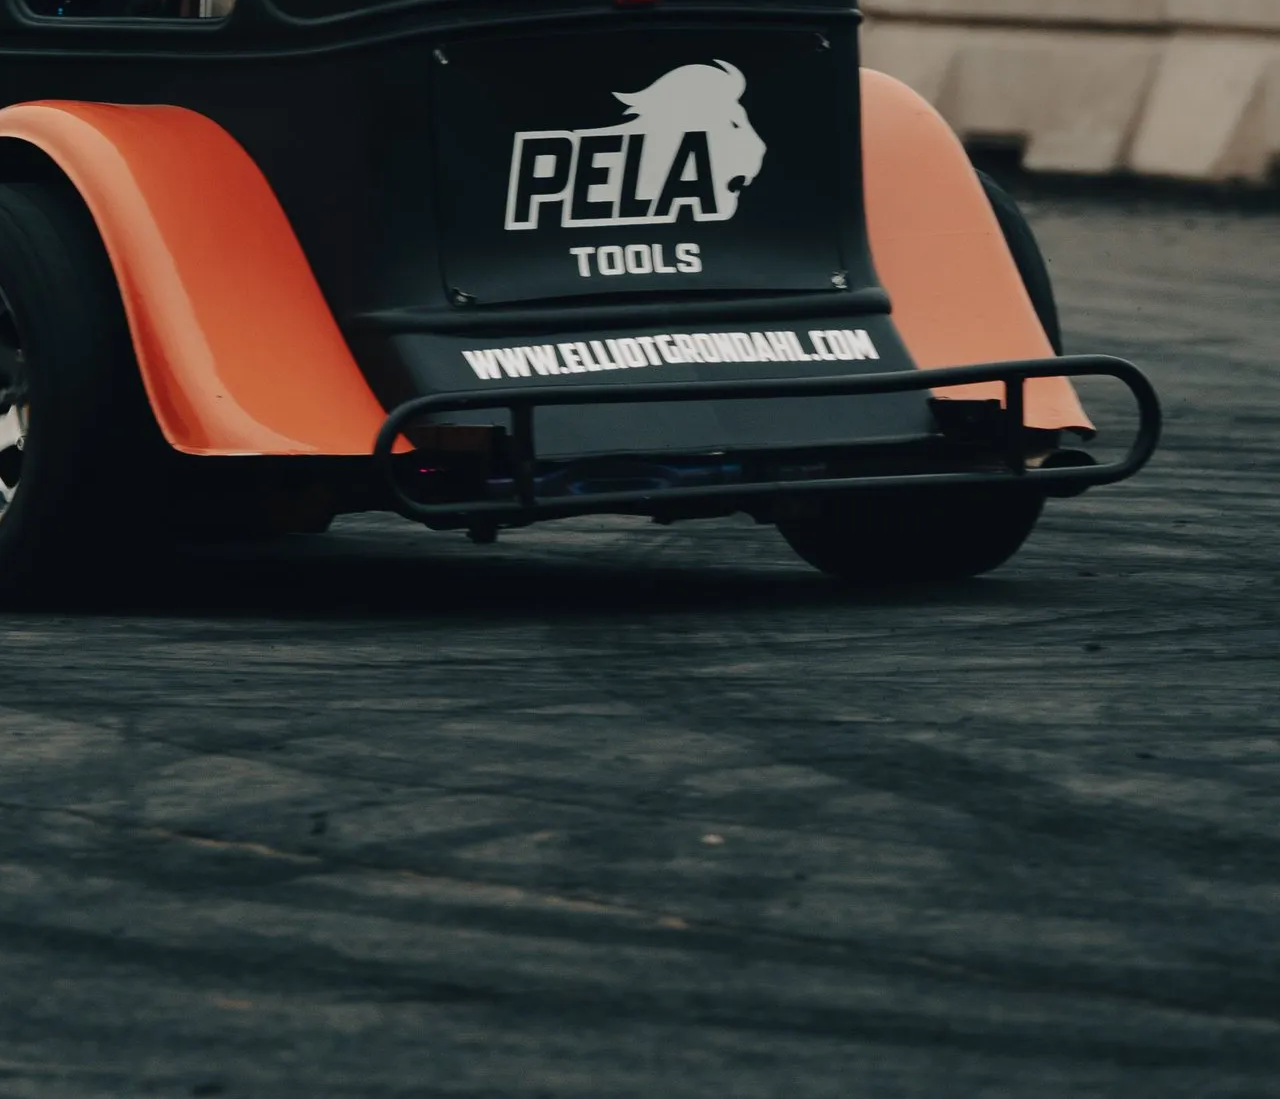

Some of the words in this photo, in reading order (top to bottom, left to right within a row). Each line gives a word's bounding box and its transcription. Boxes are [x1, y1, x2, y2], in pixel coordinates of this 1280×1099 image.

[505, 130, 722, 230] PELA
[569, 242, 703, 278] TOOLS
[461, 328, 880, 381] WWW.ELLIOTGRONDAHL.COM
